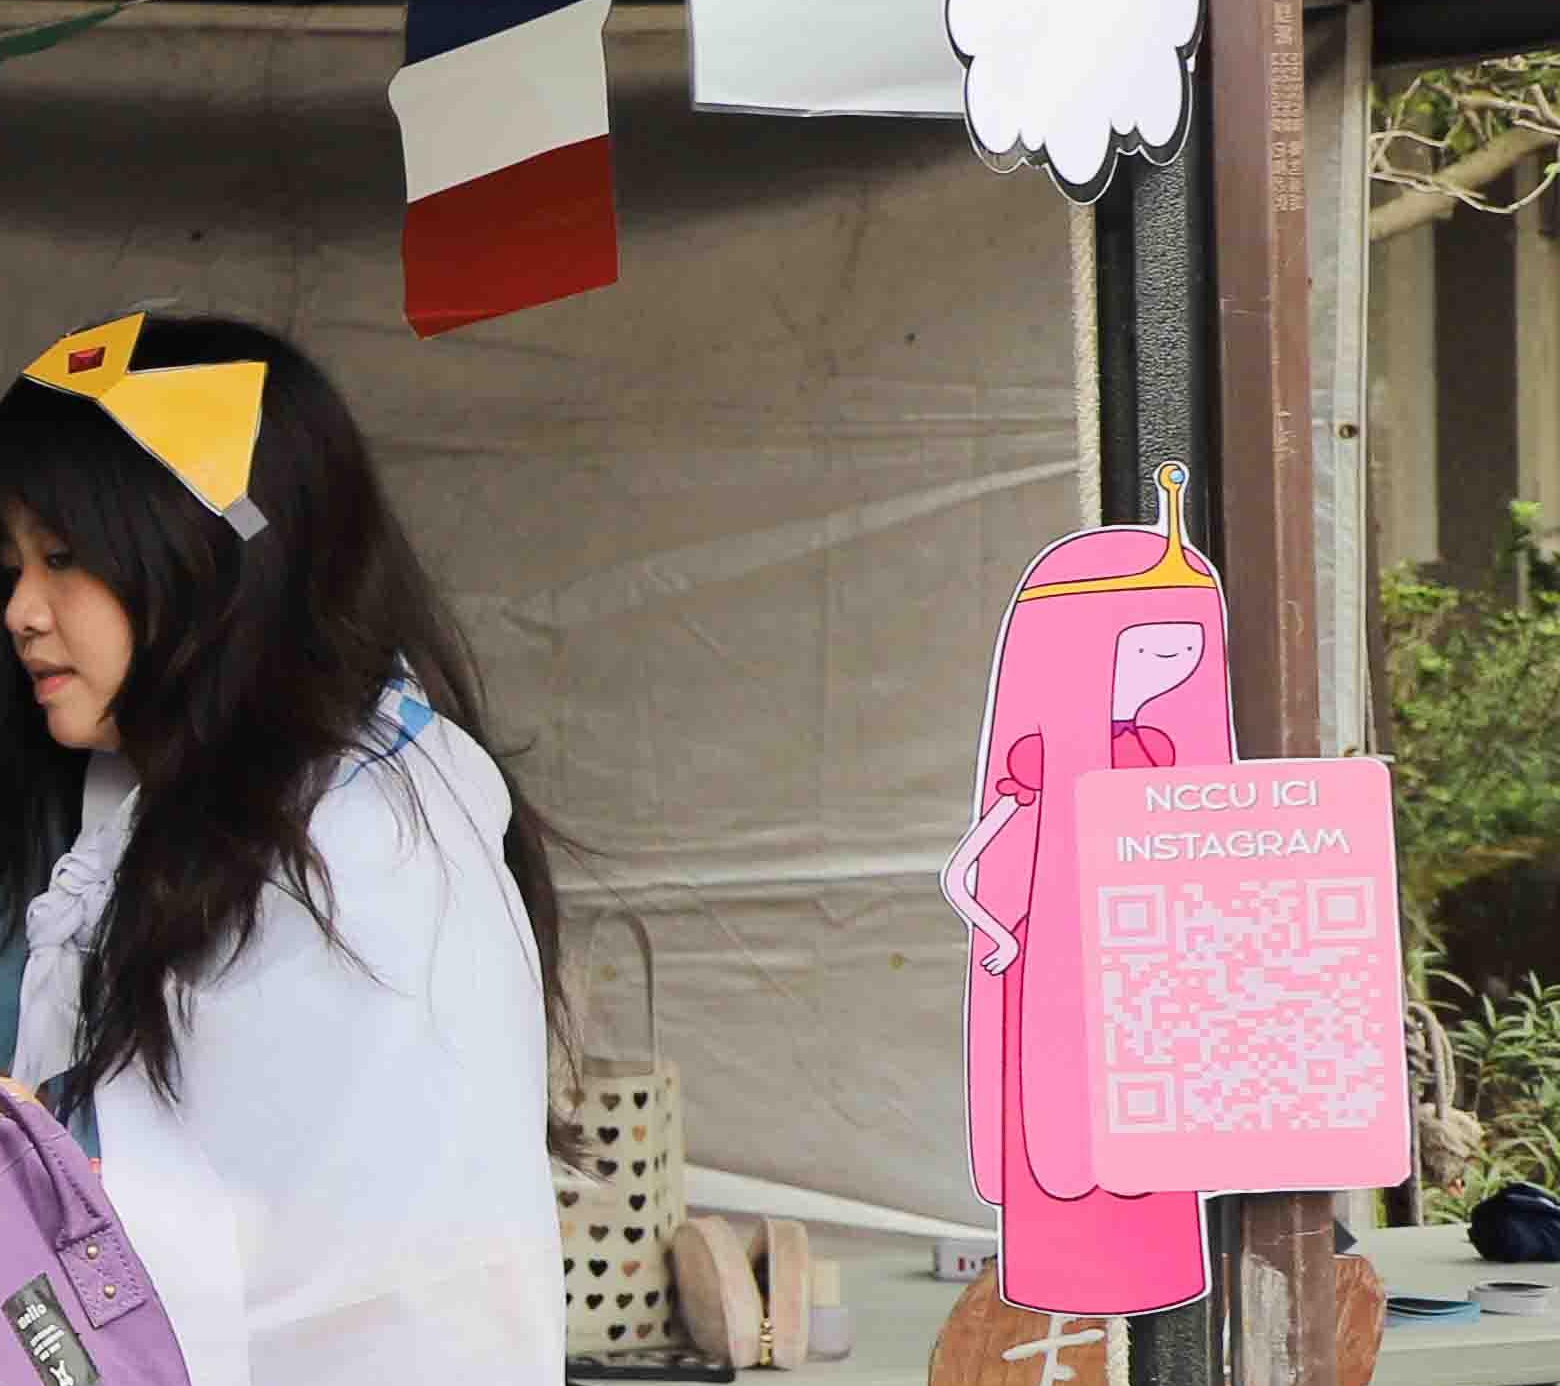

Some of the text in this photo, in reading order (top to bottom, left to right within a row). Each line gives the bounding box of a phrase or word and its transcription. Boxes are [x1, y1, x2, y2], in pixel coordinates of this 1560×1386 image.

[1145, 778, 1320, 812] NCCU ICI
[1117, 827, 1353, 862] INSTAGRAM
